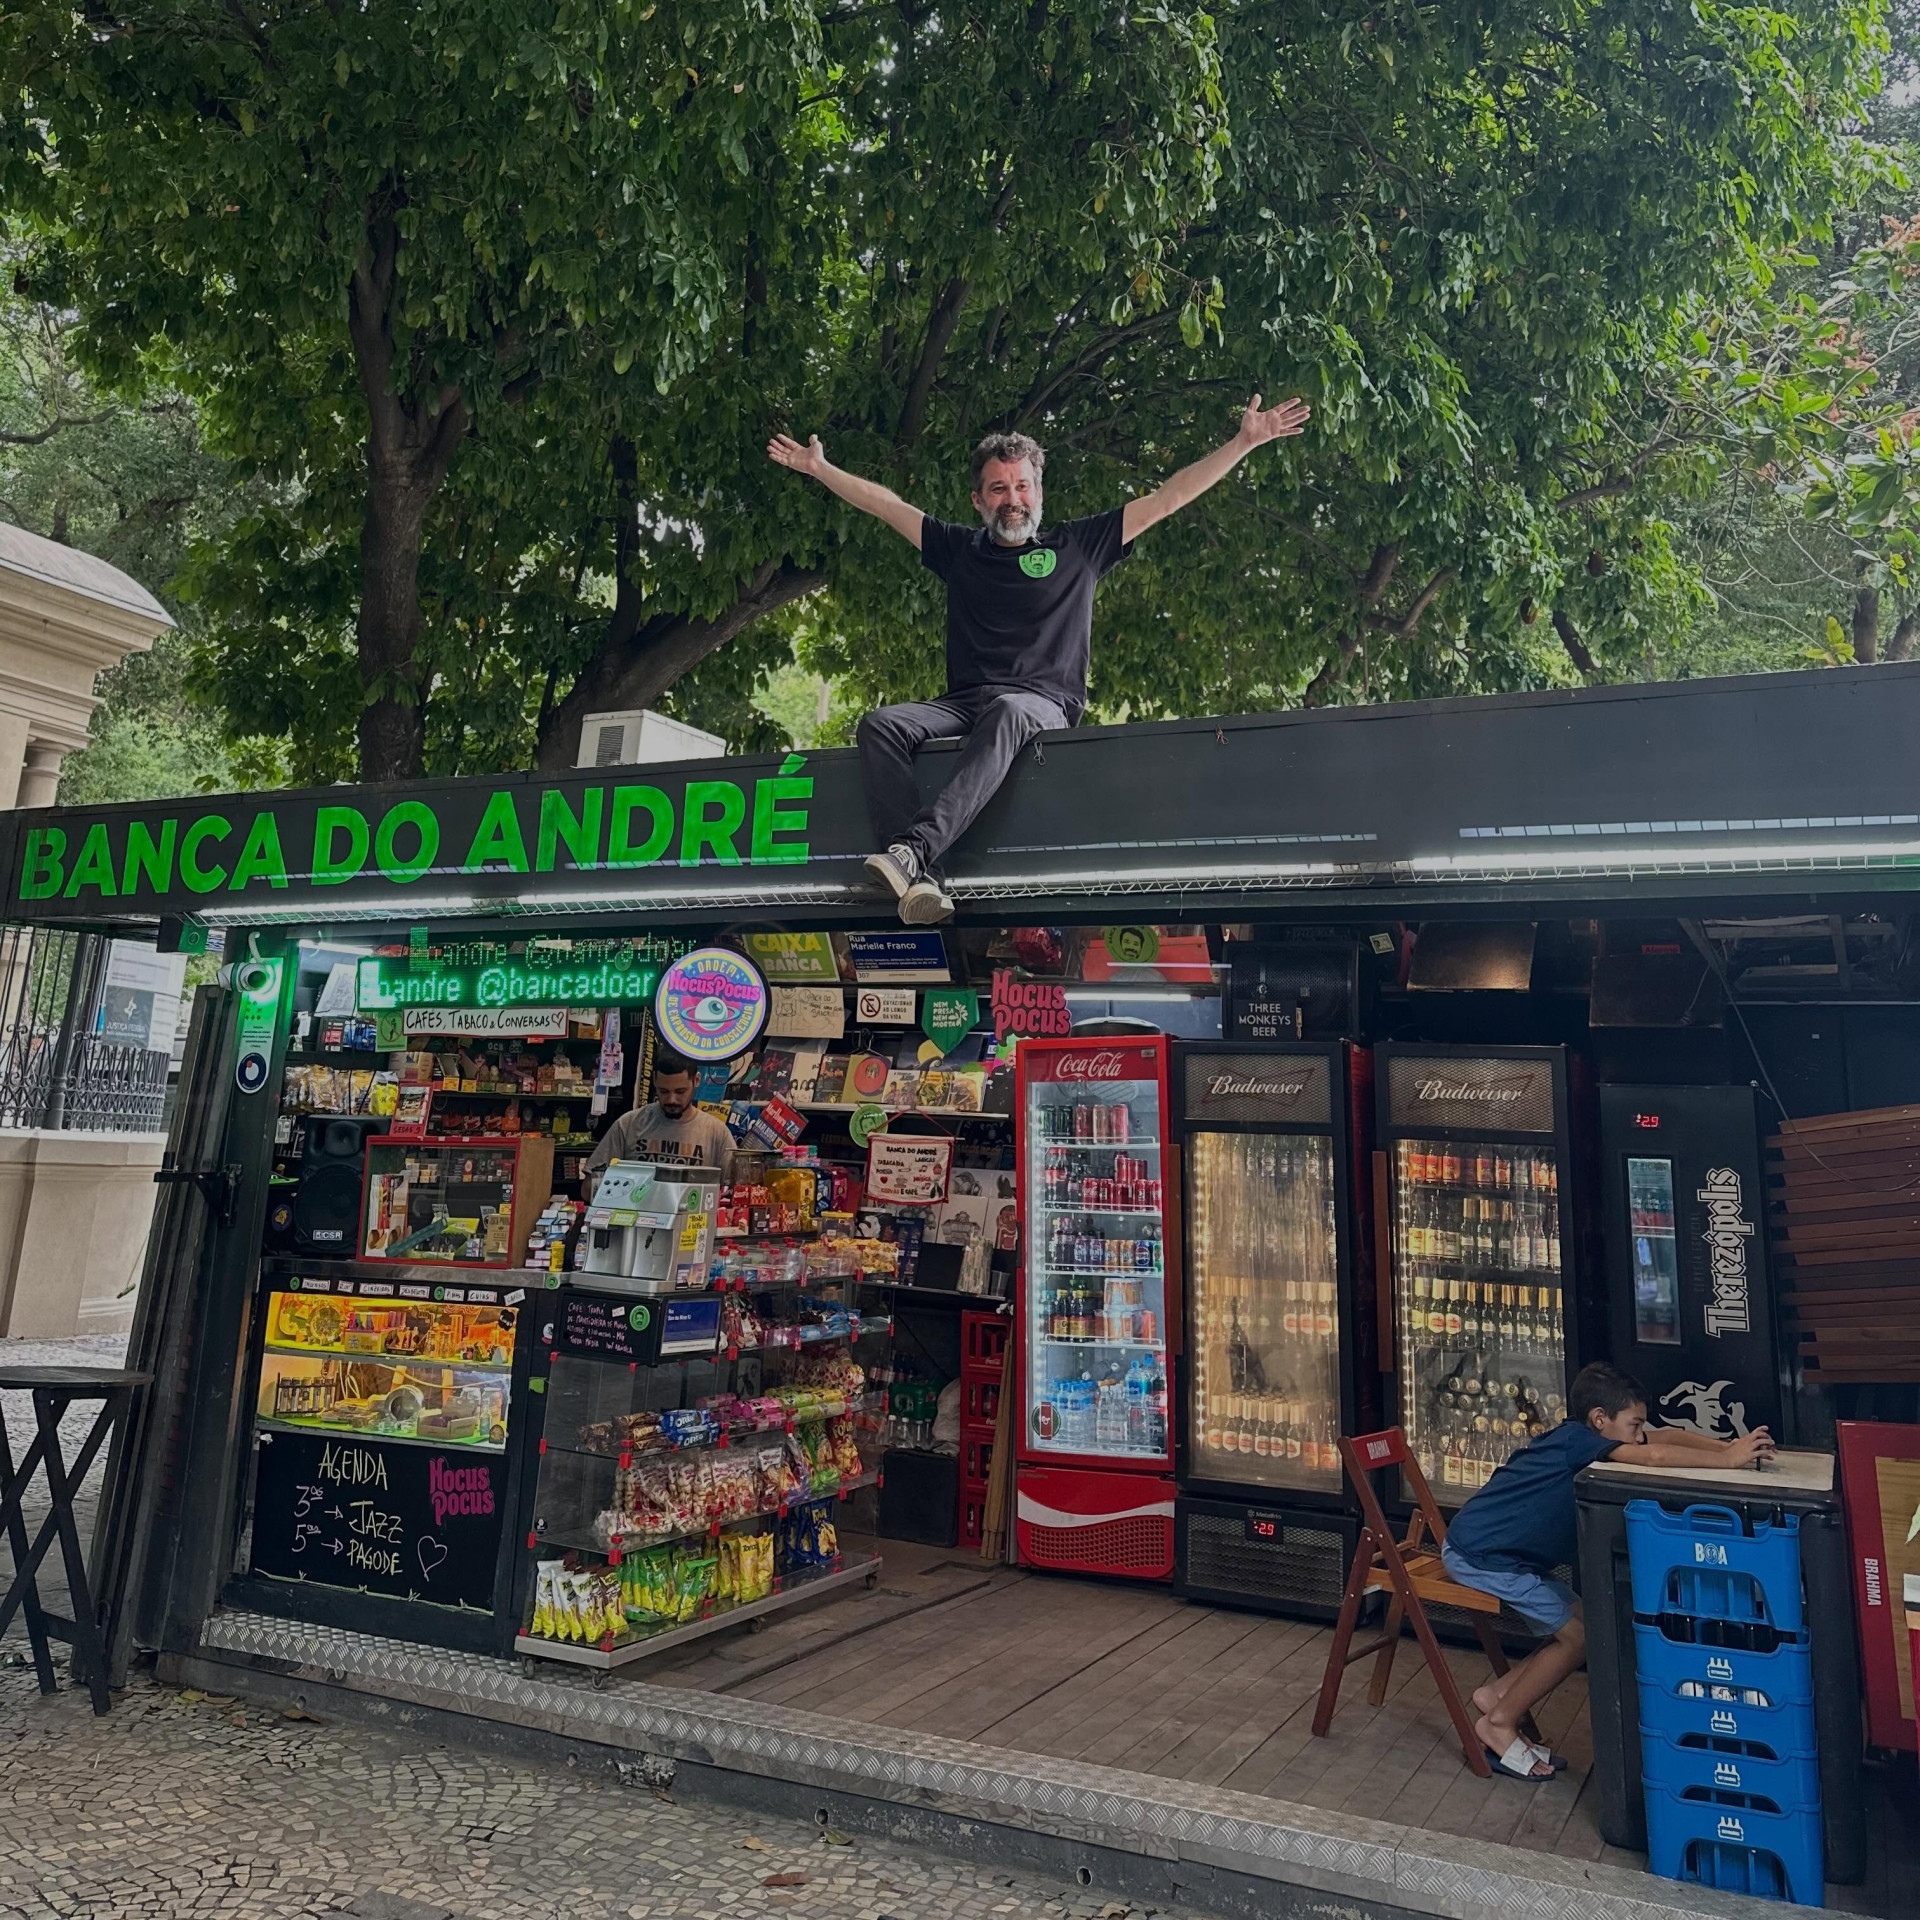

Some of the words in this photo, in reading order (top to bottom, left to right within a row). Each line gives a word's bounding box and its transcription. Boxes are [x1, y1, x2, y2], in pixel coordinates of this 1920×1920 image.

[19, 811, 289, 900] BANCA
[310, 800, 440, 886] DO
[459, 752, 814, 874] ANDRÉ
[752, 933, 822, 952] CAIXA
[849, 935, 866, 943] Rua
[851, 942, 885, 950] Marielle
[887, 942, 917, 950] Franco
[763, 958, 823, 971] BANCA
[781, 951, 798, 959] DA
[697, 960, 737, 977] ORDEM
[1248, 1003, 1282, 1013] THREE
[449, 1010, 488, 1029] TABACO
[497, 1010, 551, 1029] CONVERSAS
[932, 1020, 956, 1028] MORTA
[1238, 1015, 1291, 1025] MONKEYS
[1252, 1027, 1277, 1037] BEER
[1055, 1052, 1126, 1078] Coca-Cola
[1207, 1075, 1304, 1095] Budweiser
[1414, 1080, 1523, 1101] Budweiser
[635, 1139, 704, 1158] SAMBA
[1697, 1167, 1755, 1338] Therezópolis
[1366, 1439, 1391, 1461] BRAHMA
[317, 1441, 389, 1492] AGENDA
[348, 1500, 404, 1545] JAZZ
[346, 1538, 404, 1577] PAGODE
[1864, 1557, 1882, 1606] BRAHMA
